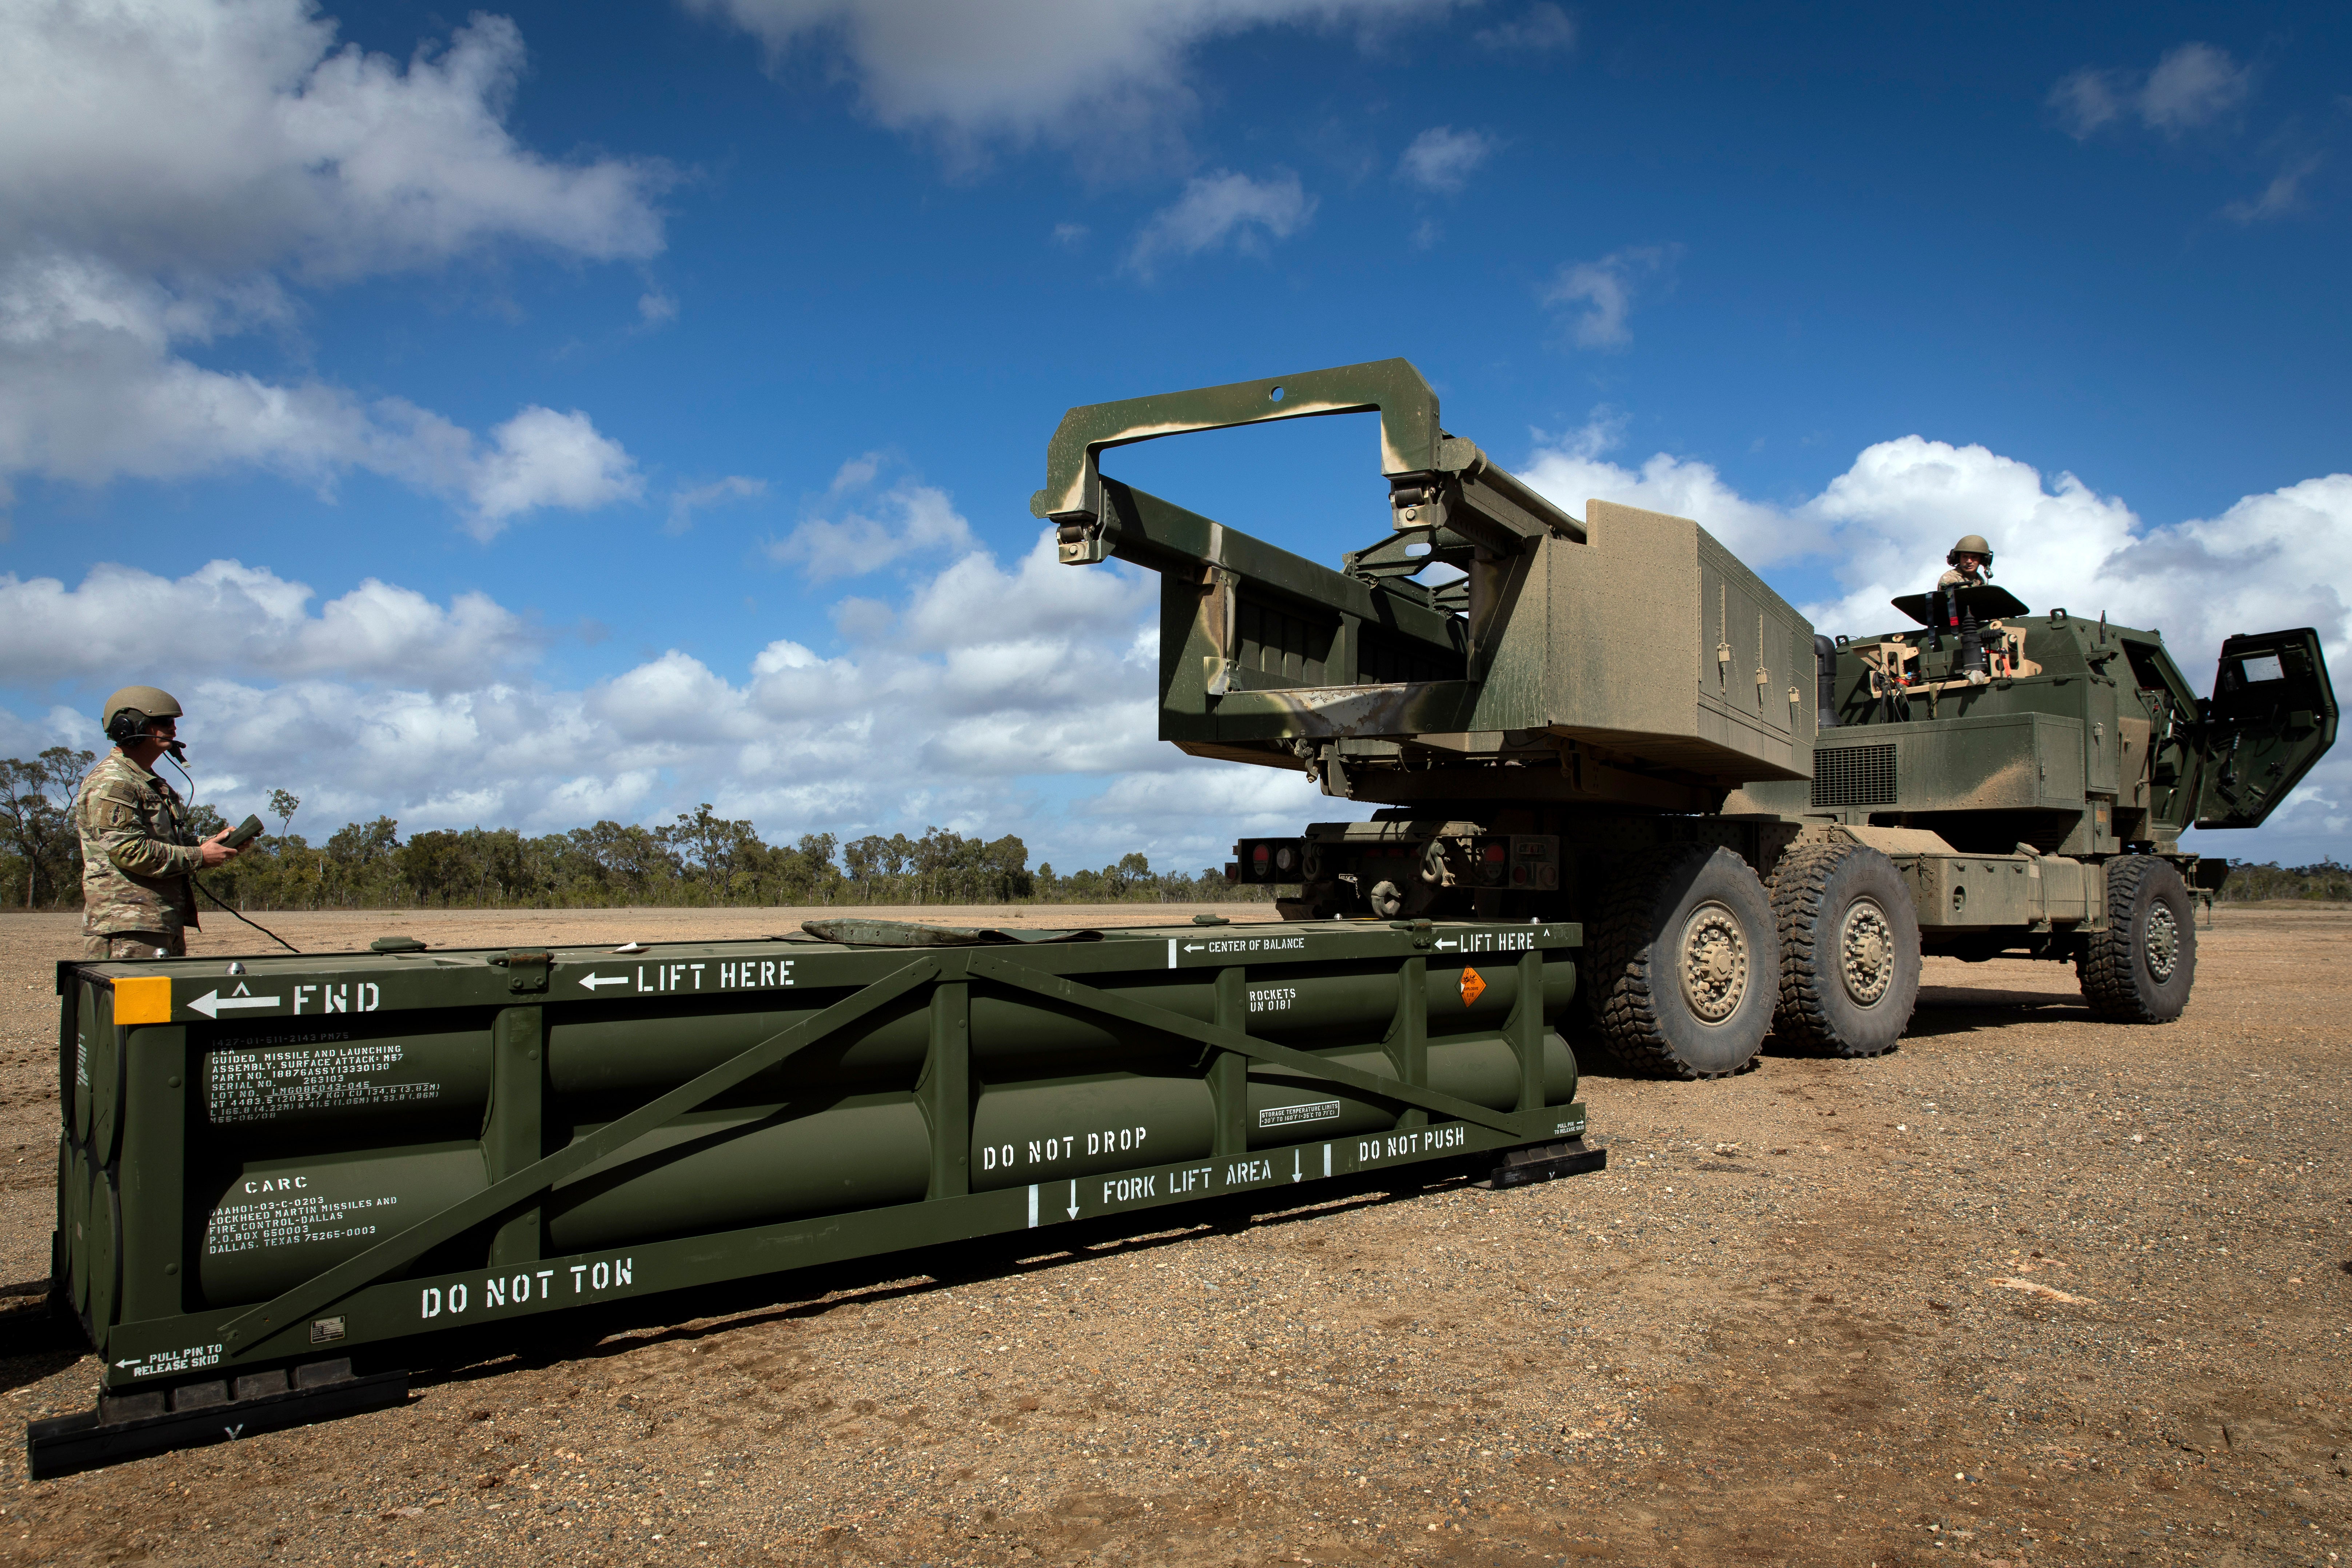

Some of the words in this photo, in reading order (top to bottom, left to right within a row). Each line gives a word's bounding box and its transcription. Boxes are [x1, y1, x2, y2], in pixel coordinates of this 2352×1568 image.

[1209, 939, 1246, 953] CENTER
[1249, 939, 1261, 951] OF
[1263, 938, 1304, 950] BALANCE
[1460, 934, 1491, 952] LIFT
[1499, 932, 1534, 951] HERE
[1727, 873, 1773, 1009] GOODYEAR
[638, 963, 705, 992] LIFT
[721, 961, 794, 988] HERE
[294, 983, 379, 1015] FWD
[1249, 988, 1296, 1002] ROCKETS
[1250, 1001, 1264, 1012] UN
[1268, 999, 1291, 1011] 0181
[212, 1054, 255, 1064] GUIDED
[264, 1051, 310, 1061] MISSILE
[315, 1049, 335, 1058] AND
[340, 1045, 401, 1056] LAUNCHING
[212, 1062, 275, 1073] ASSEMBLY,
[281, 1058, 331, 1069] SURFACE
[335, 1056, 379, 1065] ATTACK:
[212, 1073, 242, 1082] PART
[212, 1082, 252, 1091] SERIAL
[303, 1075, 344, 1085] 263103
[212, 1092, 234, 1100] LOT
[222, 1107, 249, 1115] 165.8
[255, 1102, 293, 1112] (4.22M)
[334, 1097, 369, 1106] (1.05M)
[409, 1091, 438, 1100] (.86M)
[231, 1097, 273, 1106] 4483.5
[278, 1093, 322, 1102] (2033.7
[368, 1088, 396, 1096] 134.6
[401, 1084, 440, 1093] (3.82M)
[210, 1112, 276, 1124] M55-06/08
[1287, 1106, 1320, 1115] TEMPERATURE
[984, 1144, 1014, 1170] DO
[1029, 1136, 1074, 1164] NOT
[1088, 1127, 1146, 1155] DROP
[1359, 1140, 1380, 1162] DO
[1388, 1134, 1418, 1157] NOT
[1425, 1127, 1464, 1150] PUSH
[245, 1176, 308, 1194] CARC
[1104, 1175, 1155, 1204] FORK
[1170, 1167, 1212, 1194] LIFT
[1226, 1160, 1272, 1185] AREA
[209, 1211, 270, 1226] LOCKHEED
[275, 1206, 317, 1218] MARTIN
[322, 1199, 372, 1212] MISSILES
[377, 1196, 397, 1206] AND
[209, 1225, 237, 1235] FIRE
[242, 1212, 343, 1231] CONTROL-DALLAS
[263, 1225, 309, 1237] 650003
[210, 1241, 259, 1254] DALLAS,
[264, 1236, 300, 1247] TEXAS
[305, 1226, 376, 1242] 75265-0003
[422, 1284, 467, 1318] DO
[487, 1270, 554, 1308] NOT
[570, 1258, 632, 1293] TOW
[149, 1350, 180, 1364] PULL
[183, 1346, 204, 1357] PIN
[207, 1343, 222, 1354] TO
[133, 1360, 188, 1377] RELEASE
[191, 1354, 219, 1367] SKID
